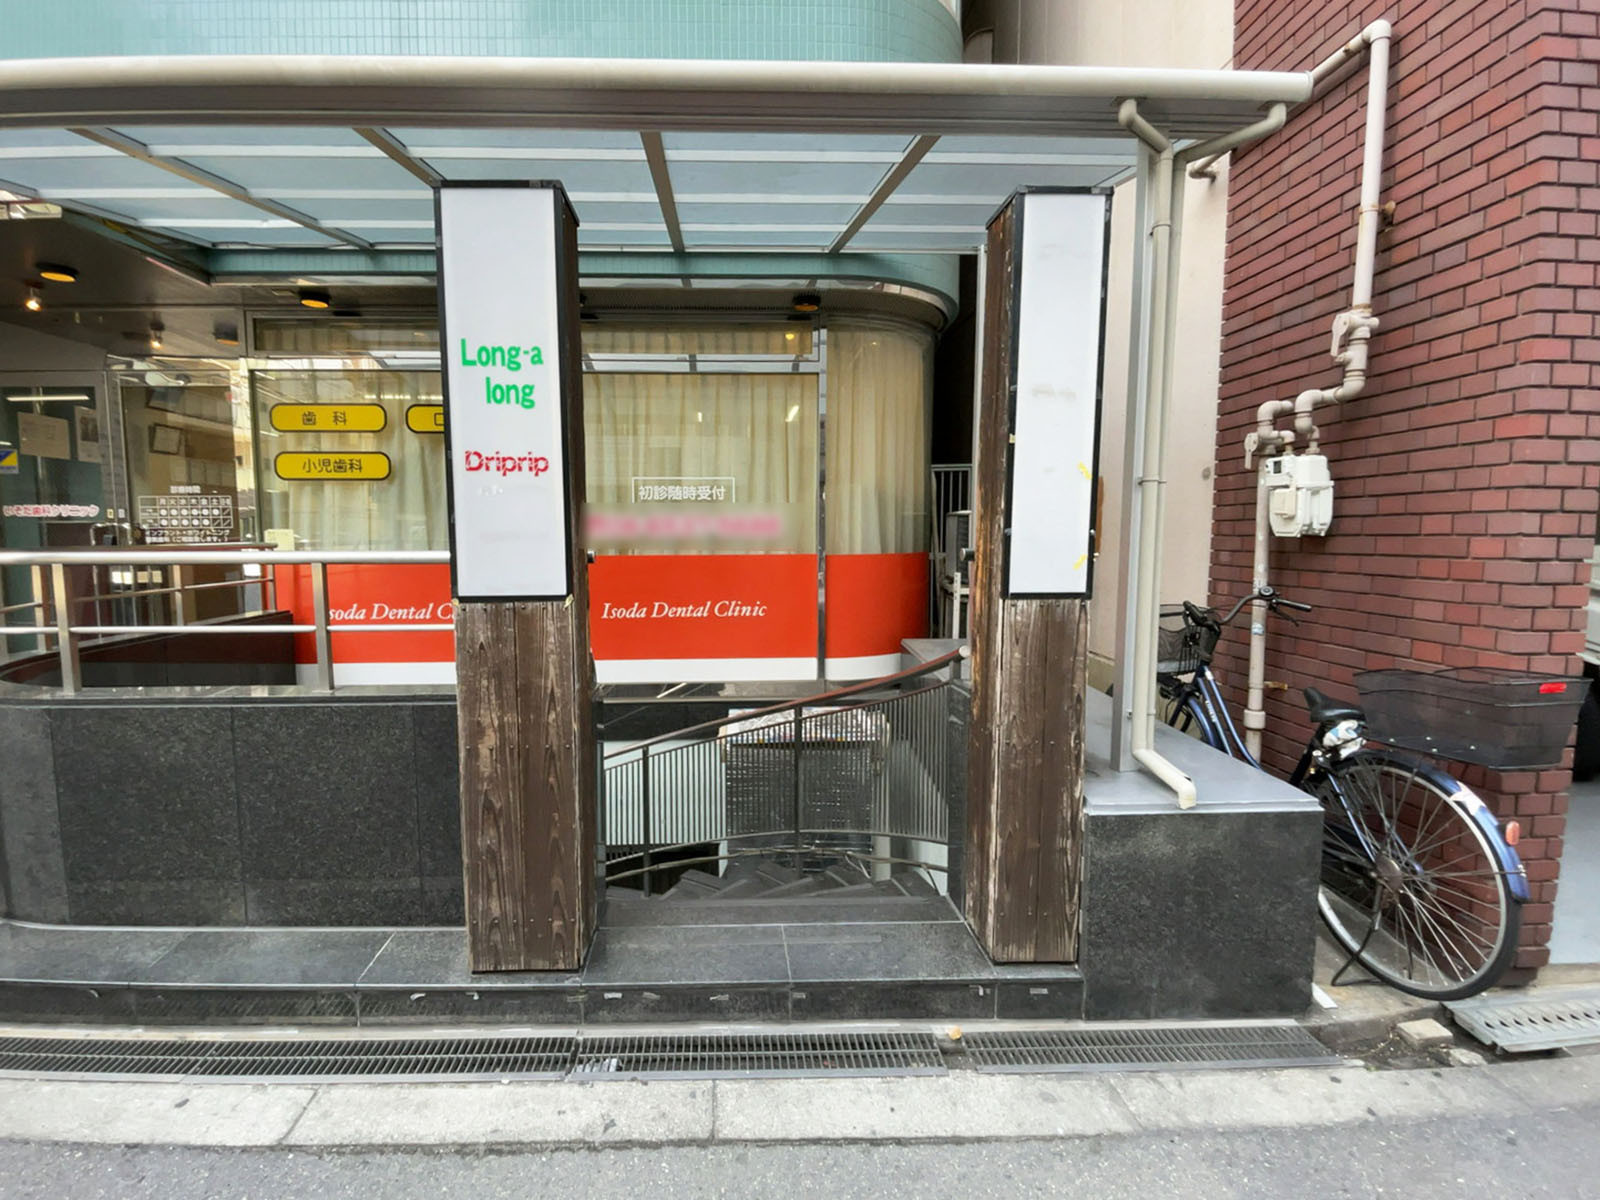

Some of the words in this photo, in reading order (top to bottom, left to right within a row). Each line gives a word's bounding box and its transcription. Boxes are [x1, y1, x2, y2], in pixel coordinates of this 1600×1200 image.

[460, 338, 544, 371] Long-a
[485, 376, 536, 409] long
[302, 458, 363, 474] 小児歯科
[464, 450, 549, 477] Driprip
[638, 484, 726, 501] 初診随時受付
[329, 603, 367, 620] soda
[370, 602, 435, 620] Dental
[601, 602, 648, 620] Isoda
[651, 601, 711, 619] Dental
[714, 600, 768, 618] Clinic
